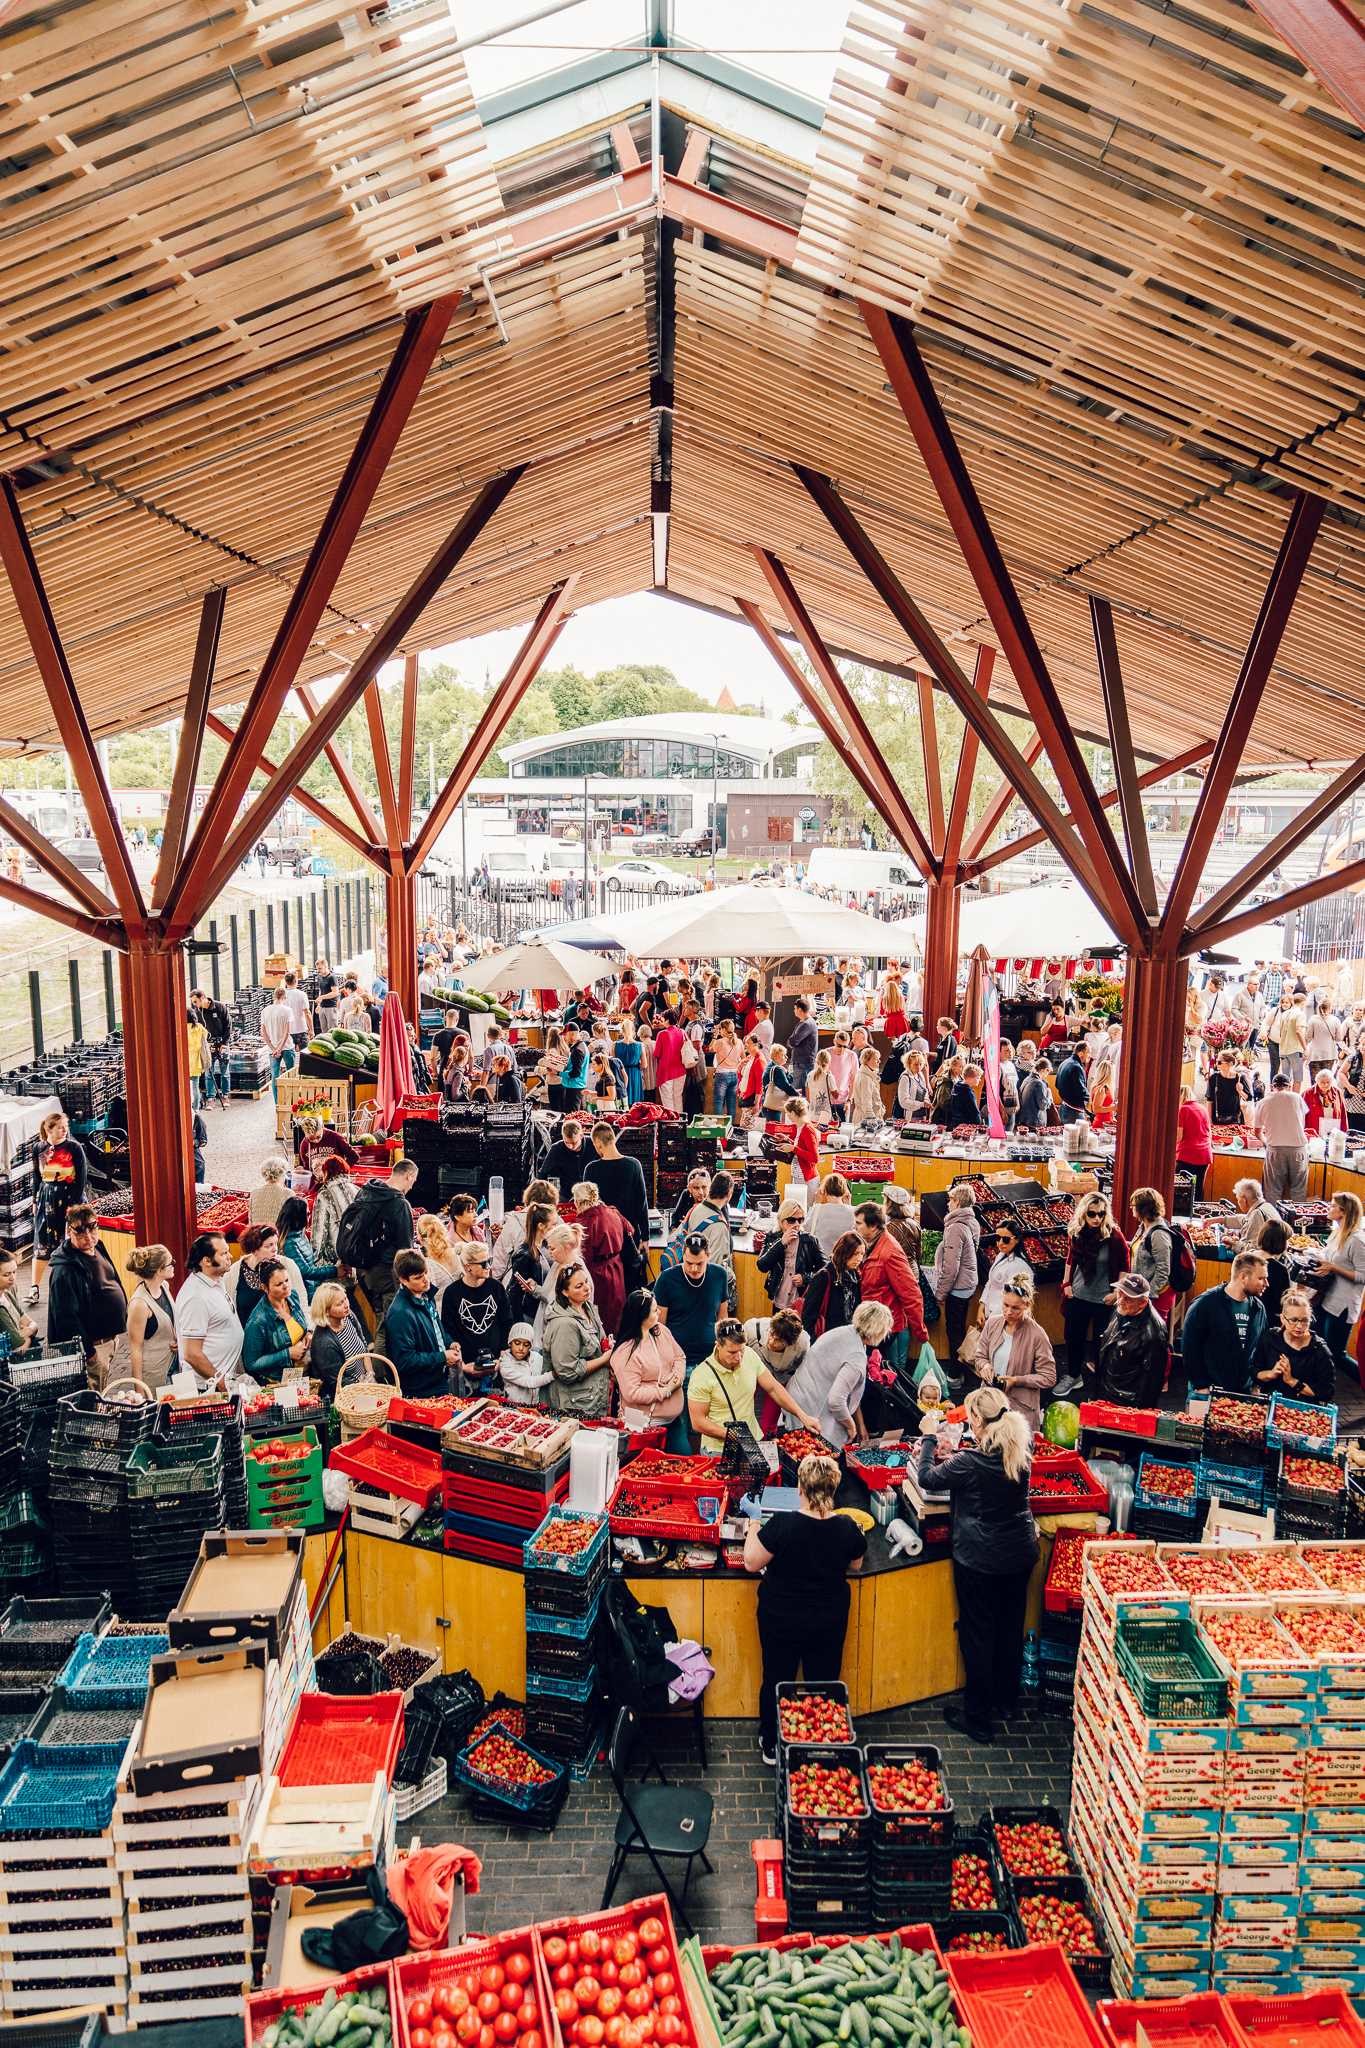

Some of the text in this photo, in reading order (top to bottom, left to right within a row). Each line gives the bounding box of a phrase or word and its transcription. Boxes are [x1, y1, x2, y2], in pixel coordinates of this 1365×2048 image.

[1162, 1767, 1197, 1776] George
[1247, 1767, 1281, 1776] George
[1156, 1877, 1190, 1886] George
[1236, 1933, 1271, 1942] George
